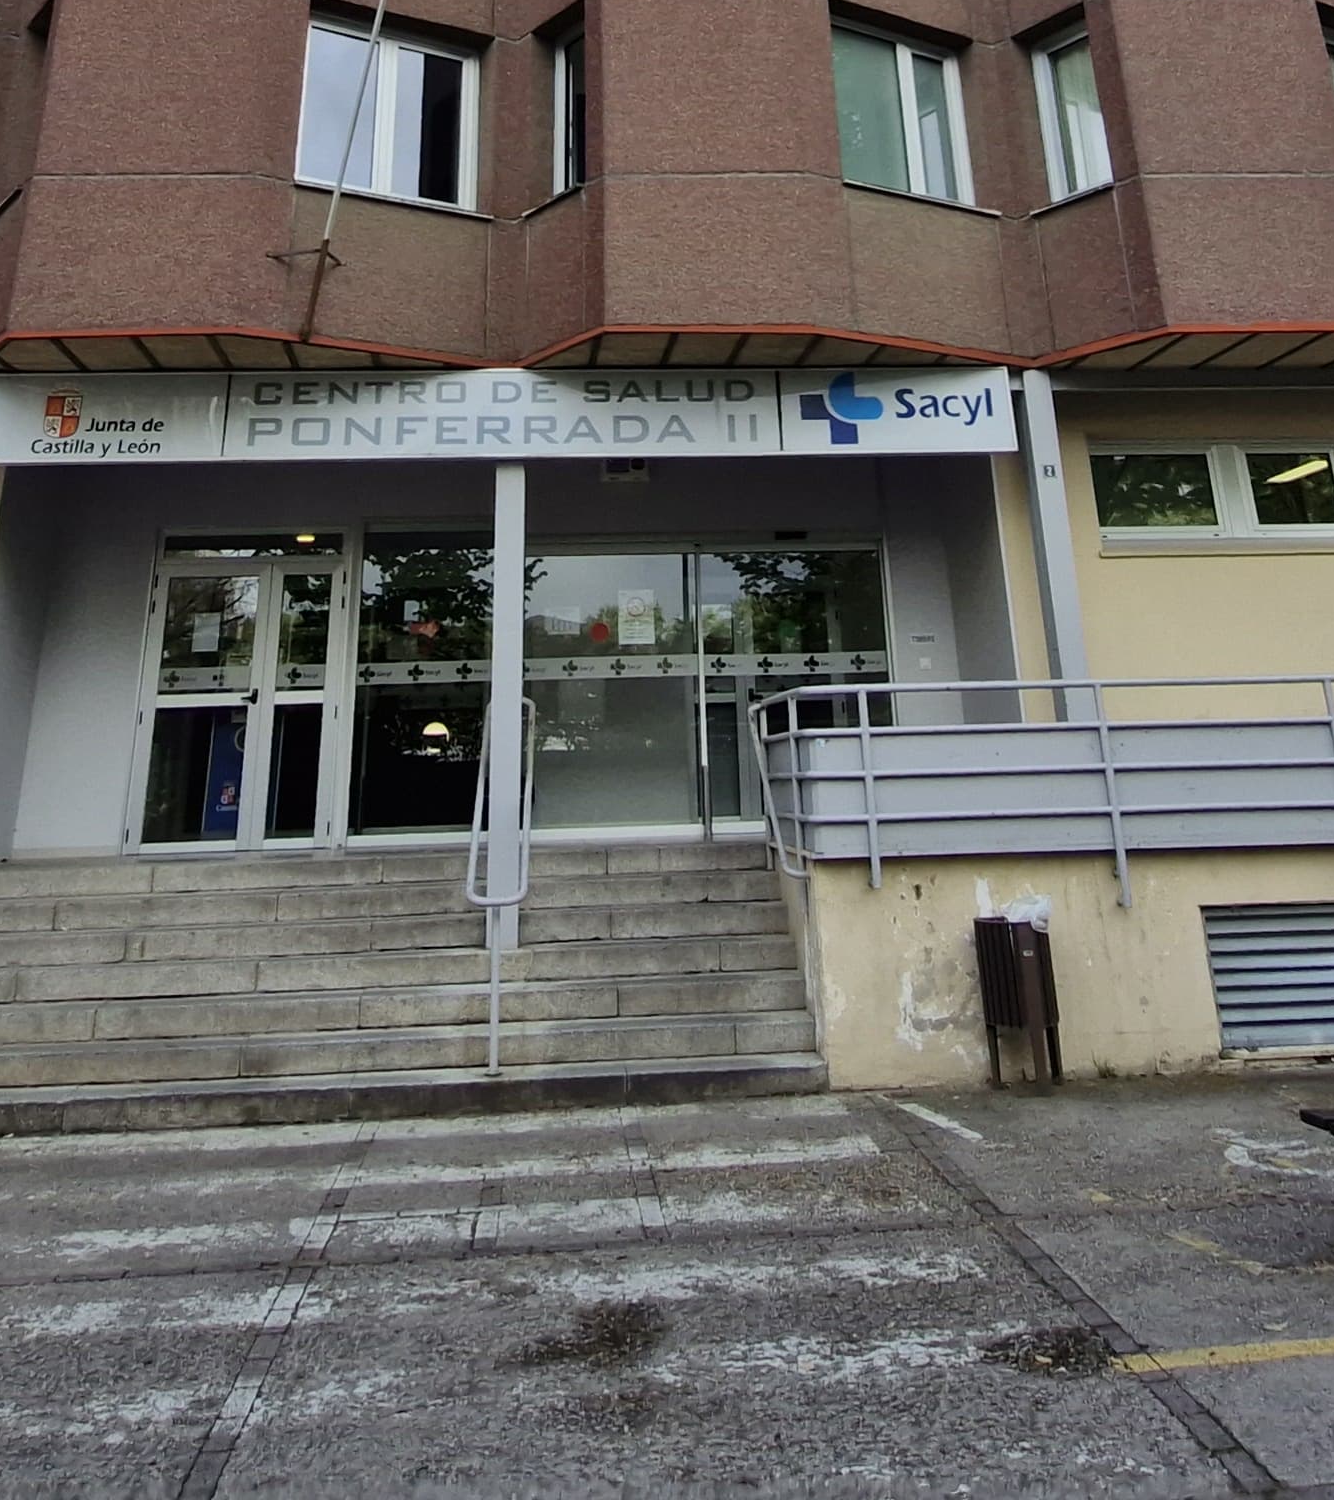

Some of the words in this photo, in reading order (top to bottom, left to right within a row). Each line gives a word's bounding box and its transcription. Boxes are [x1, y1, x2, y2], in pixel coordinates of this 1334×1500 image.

[254, 381, 466, 405] CENTRO
[491, 380, 557, 403] DE
[583, 379, 755, 403] SALUD
[895, 388, 993, 426] Sacyl
[85, 418, 135, 432] Junta
[142, 418, 164, 432] de
[247, 414, 696, 446] PONFERRADA
[727, 414, 758, 443] II
[31, 439, 94, 454] Castilla
[99, 442, 111, 458] y
[117, 438, 161, 454] León
